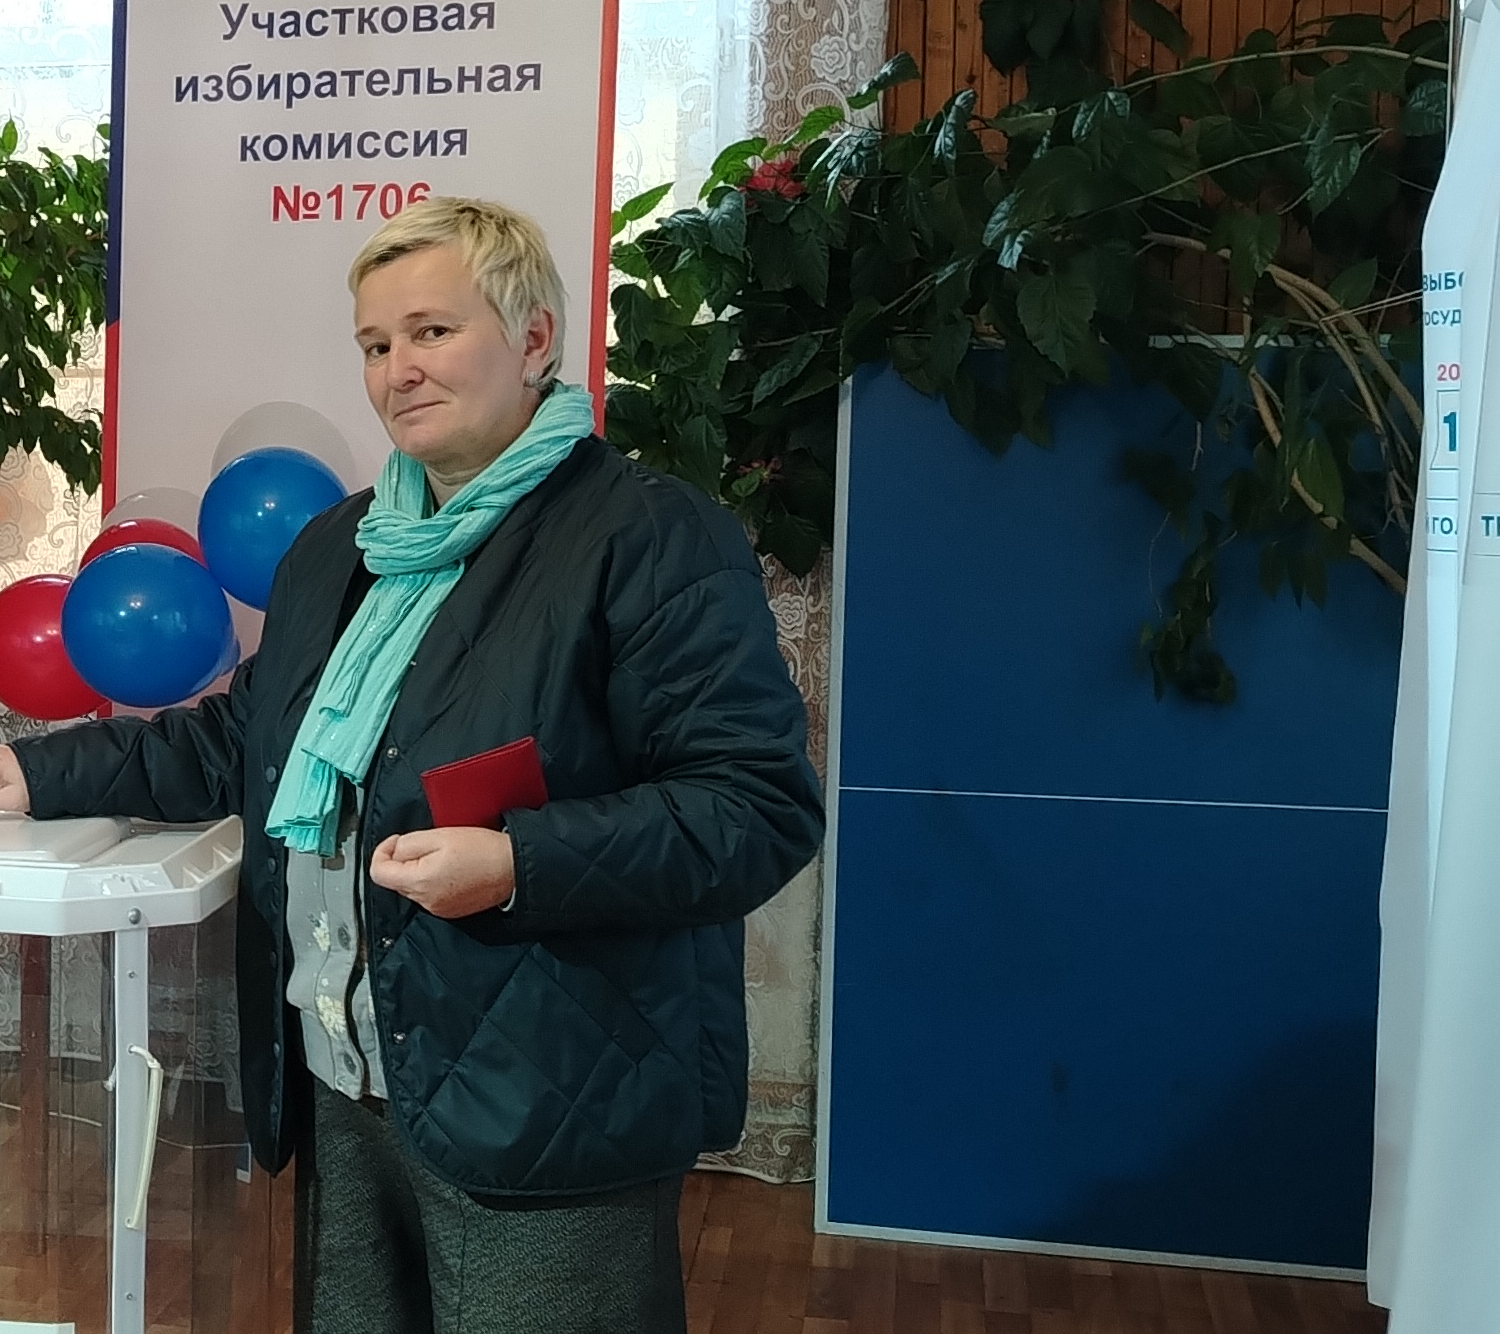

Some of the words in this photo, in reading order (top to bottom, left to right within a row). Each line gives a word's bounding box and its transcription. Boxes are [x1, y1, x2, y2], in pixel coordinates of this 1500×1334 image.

[220, 1, 496, 40] Участковая
[174, 62, 542, 108] избирательная
[240, 128, 468, 162] комиссия
